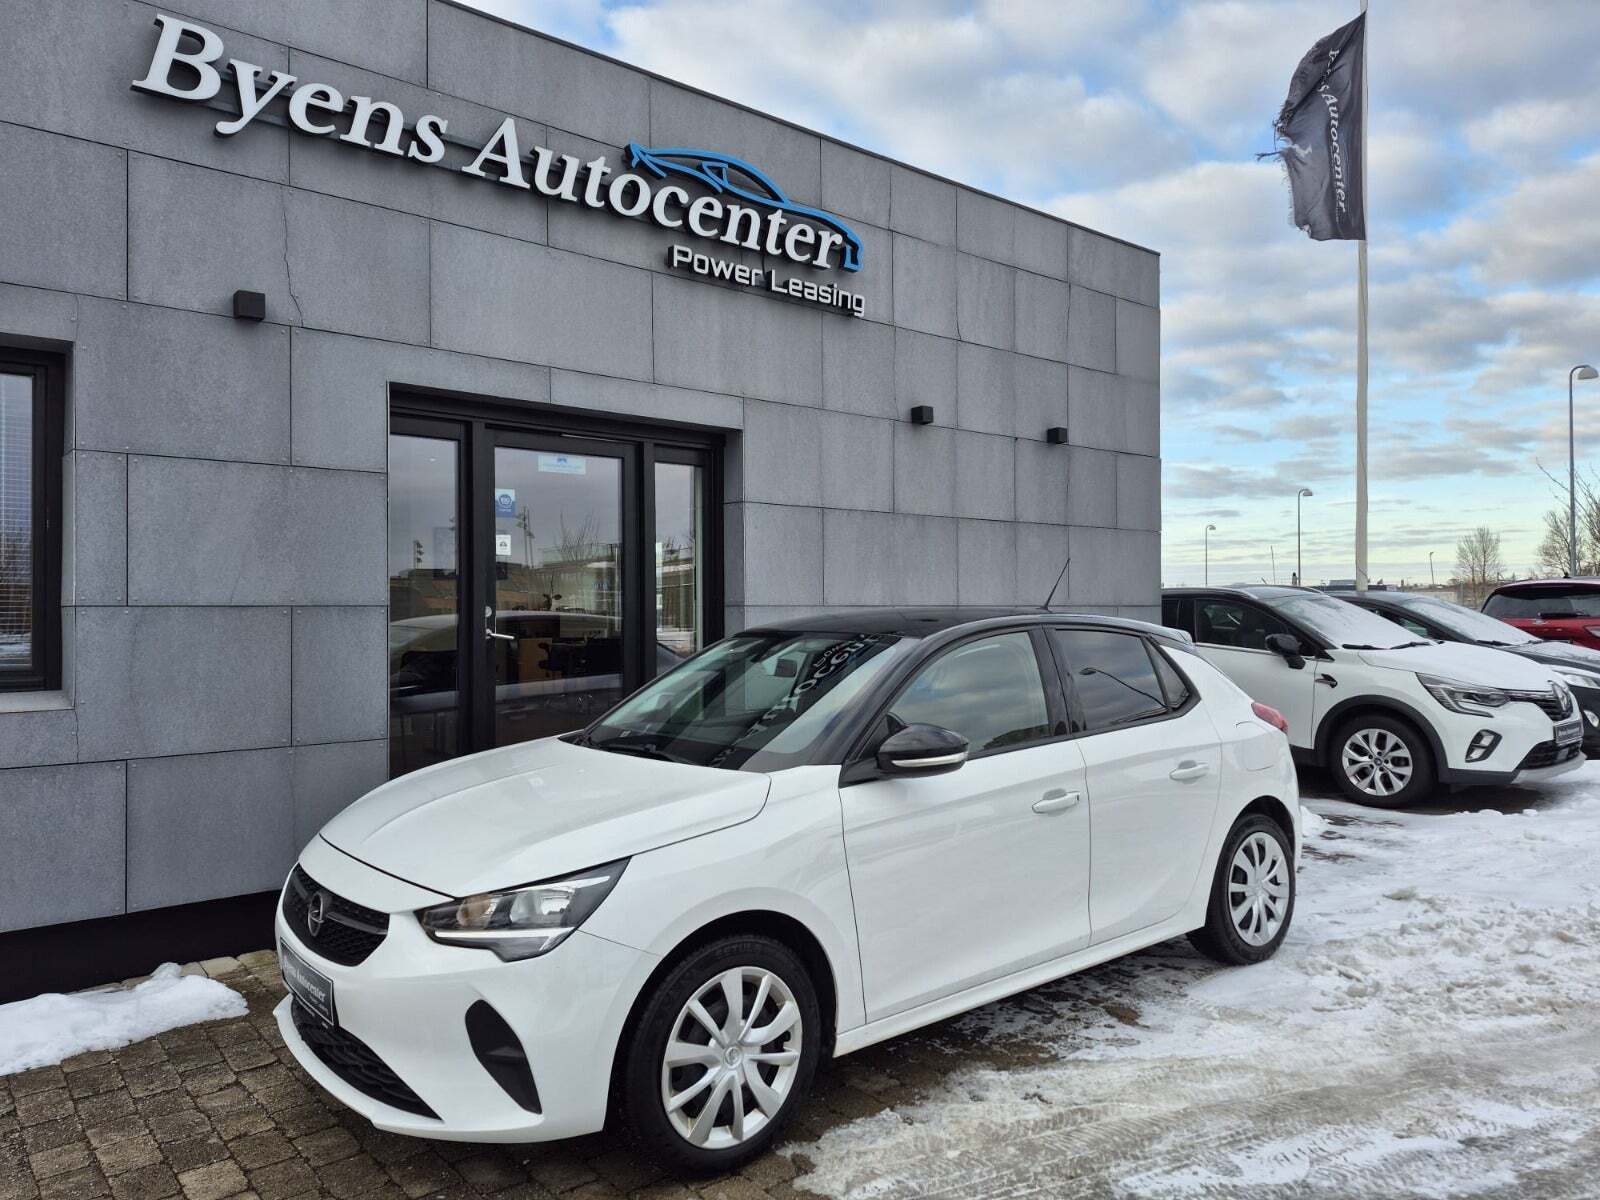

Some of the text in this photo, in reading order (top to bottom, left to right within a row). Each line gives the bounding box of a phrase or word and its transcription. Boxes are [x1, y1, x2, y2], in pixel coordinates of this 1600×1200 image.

[131, 13, 843, 270] Byens Autocenter
[1321, 93, 1347, 214] Autocenter
[672, 244, 866, 318] Power Leasing
